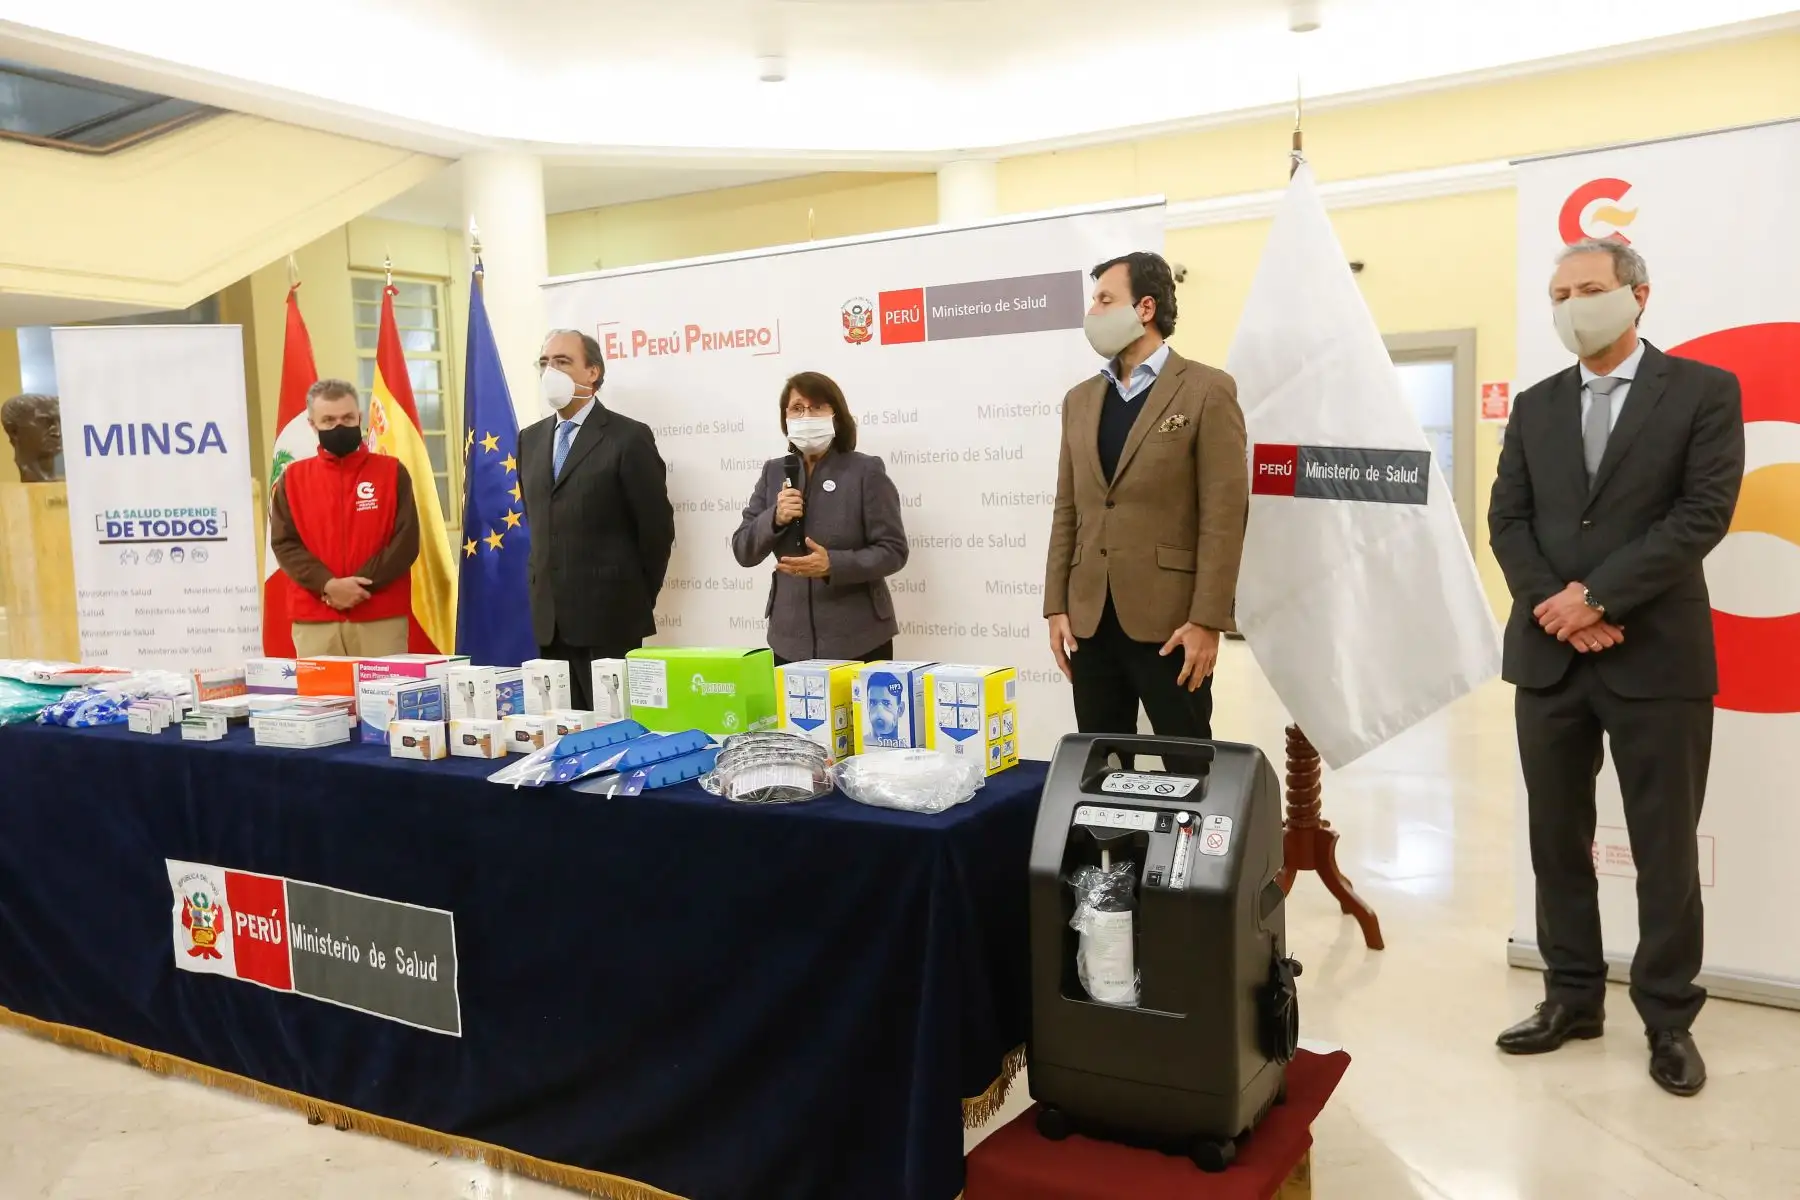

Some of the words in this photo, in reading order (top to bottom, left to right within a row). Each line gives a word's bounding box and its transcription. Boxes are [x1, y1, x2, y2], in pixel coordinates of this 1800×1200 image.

[885, 304, 920, 324] PERÚ
[932, 302, 992, 318] Ministerio
[995, 300, 1010, 313] de
[1013, 295, 1047, 310] Salud
[632, 330, 680, 358] PERÚ
[684, 324, 772, 354] PRIMERO
[860, 411, 878, 426] de
[882, 408, 918, 424] Salud
[977, 401, 1051, 420] Ministerio
[653, 423, 693, 437] nisterio
[695, 422, 710, 434] de
[713, 419, 744, 432] Salud
[83, 422, 228, 457] MINSA
[890, 448, 960, 465] Ministerio
[963, 446, 980, 462] de
[984, 444, 1023, 461] Salud
[720, 457, 765, 471] Ministe
[1259, 460, 1292, 476] PERÚ
[1306, 462, 1360, 481] Ministerio
[1365, 464, 1380, 482] de
[1386, 464, 1418, 485] Salud
[700, 498, 714, 512] de
[902, 493, 922, 508] lud
[981, 490, 1054, 508] Ministerio
[105, 510, 120, 520] LA
[122, 508, 161, 519] SALUD
[164, 508, 218, 518] DEPENDE
[106, 520, 134, 538] DE
[138, 520, 218, 537] TODOS
[908, 534, 962, 549] inisterio
[967, 535, 984, 548] de
[988, 534, 1026, 548] Salud
[664, 578, 702, 590] nisterio
[705, 577, 718, 590] de
[722, 577, 753, 590] Salud
[890, 579, 926, 594] Salud
[985, 580, 1044, 596] Minister
[900, 620, 966, 637] Ministerio
[970, 622, 987, 638] de
[992, 622, 1030, 639] Salud
[877, 736, 908, 748] Smart
[234, 908, 282, 945] PERÚ
[292, 922, 360, 964] Ministerio
[368, 941, 386, 970] de
[396, 946, 438, 982] Salud
